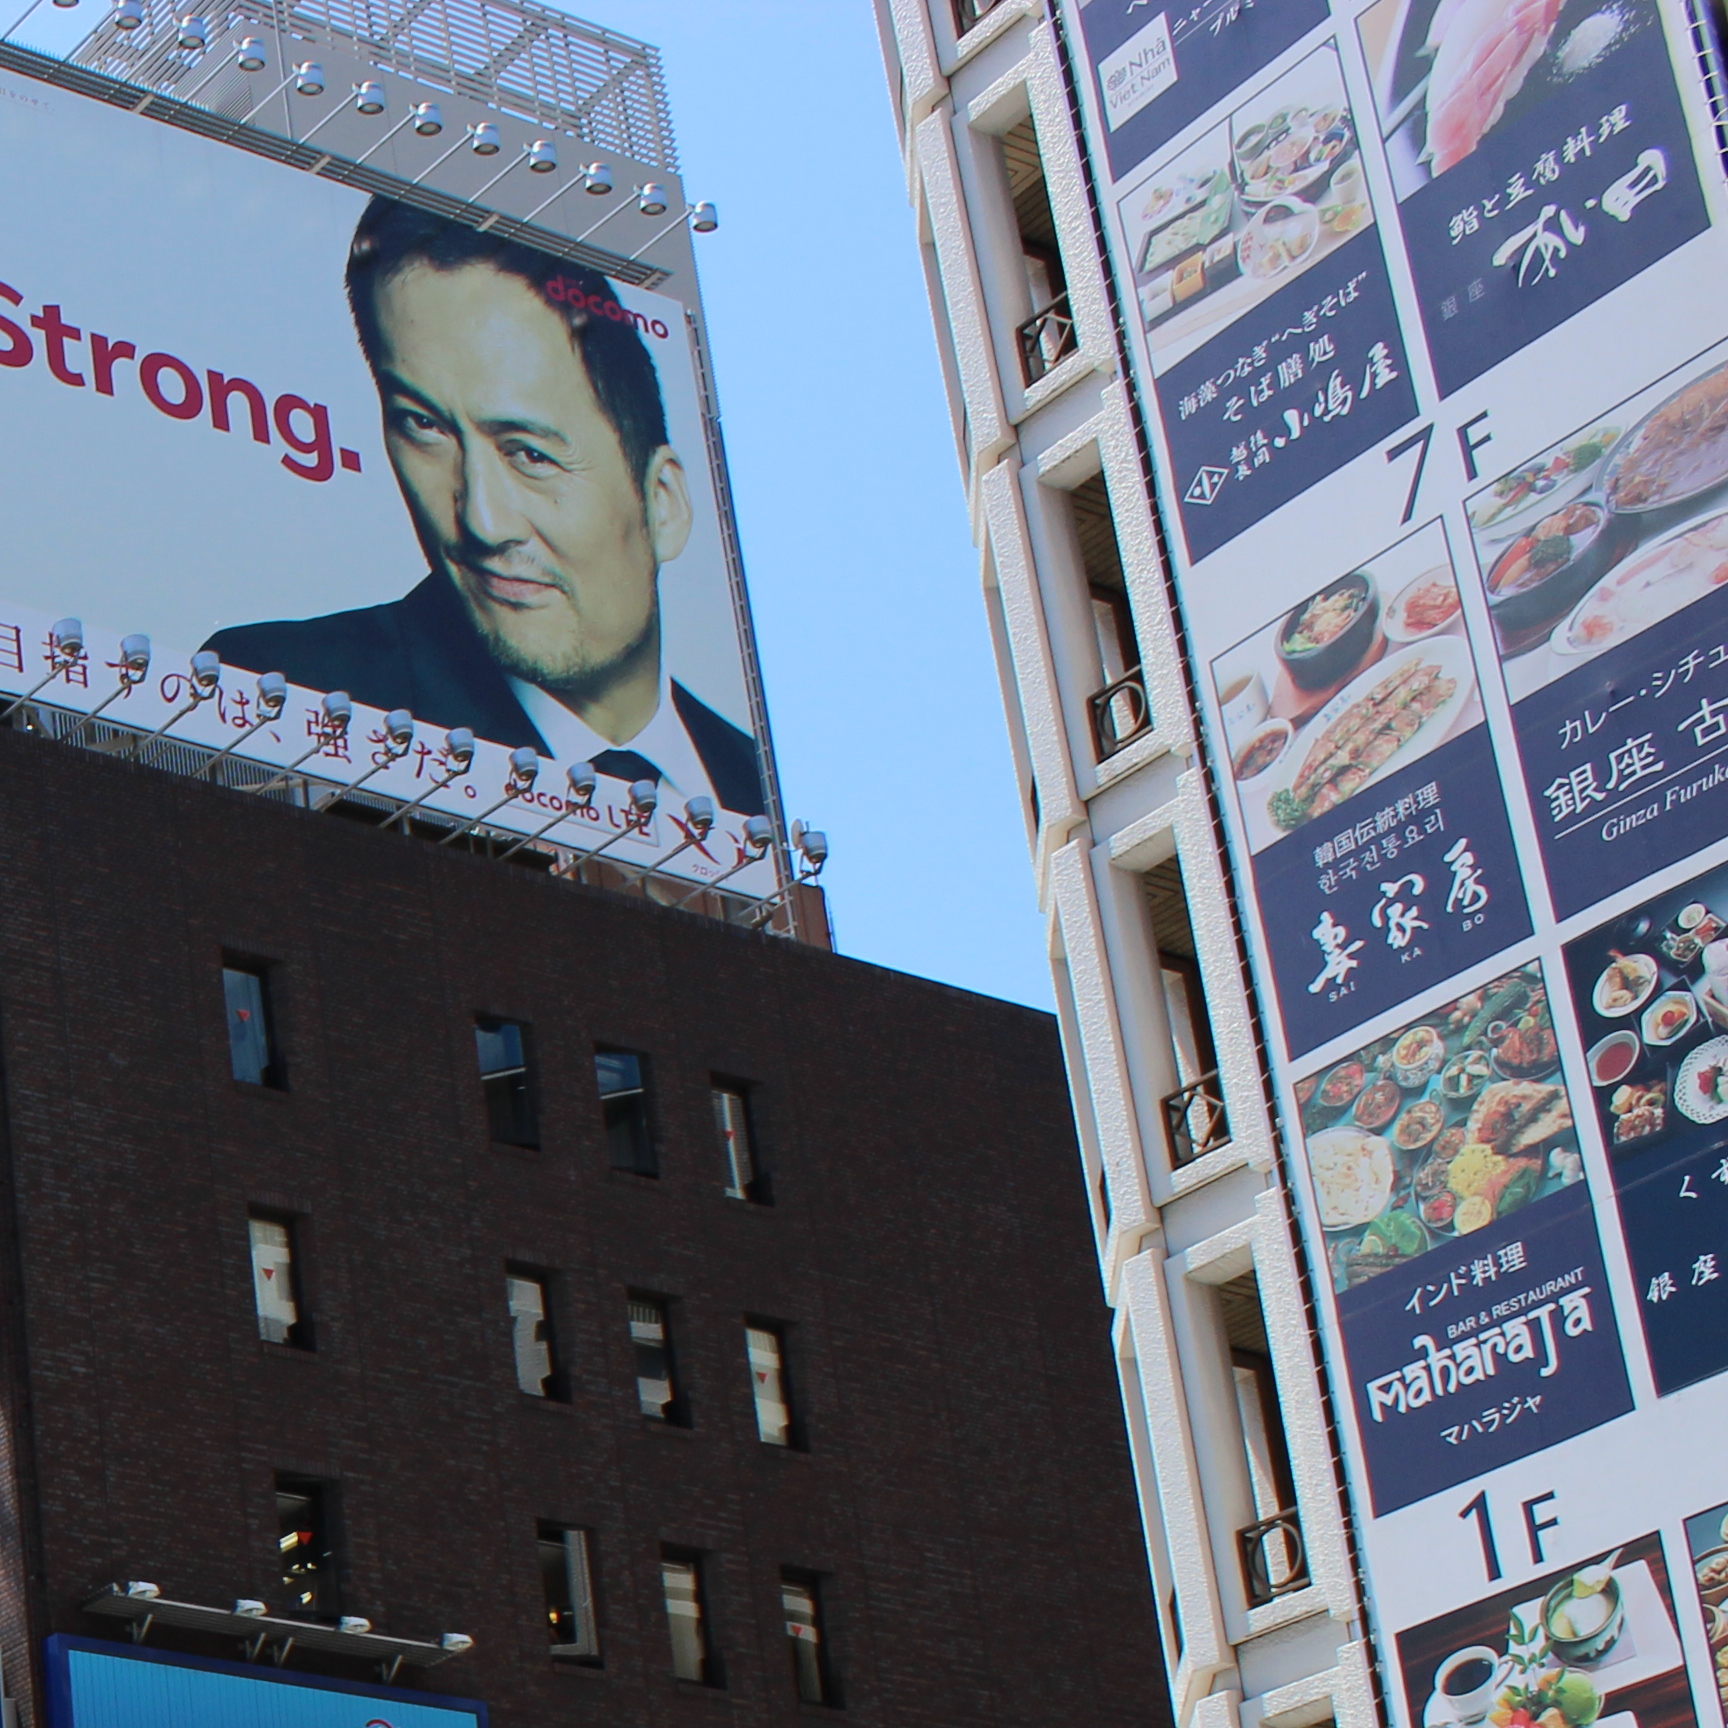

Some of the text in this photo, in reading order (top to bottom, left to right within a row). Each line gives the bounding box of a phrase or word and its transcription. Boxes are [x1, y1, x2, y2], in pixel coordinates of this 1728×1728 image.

[1448, 103, 1633, 247] 鮨と豆腐料理
[545, 274, 669, 340] docomo
[1221, 334, 1336, 423] そば膳処
[1384, 410, 1495, 528] 7F
[1542, 732, 1665, 823] 銀座
[1312, 780, 1440, 871] 韓国伝統料理
[1317, 809, 1445, 893] 한국전통요리
[1600, 802, 1659, 843] Ginza
[1327, 912, 1486, 1004] SAI KA BO
[1404, 1240, 1529, 1316] インド料理
[1445, 1266, 1586, 1340] BAR & RESTAURANT
[1645, 1252, 1721, 1304] 銀座
[1440, 1392, 1544, 1447] マハラジャ
[1457, 1489, 1560, 1584] 1F
